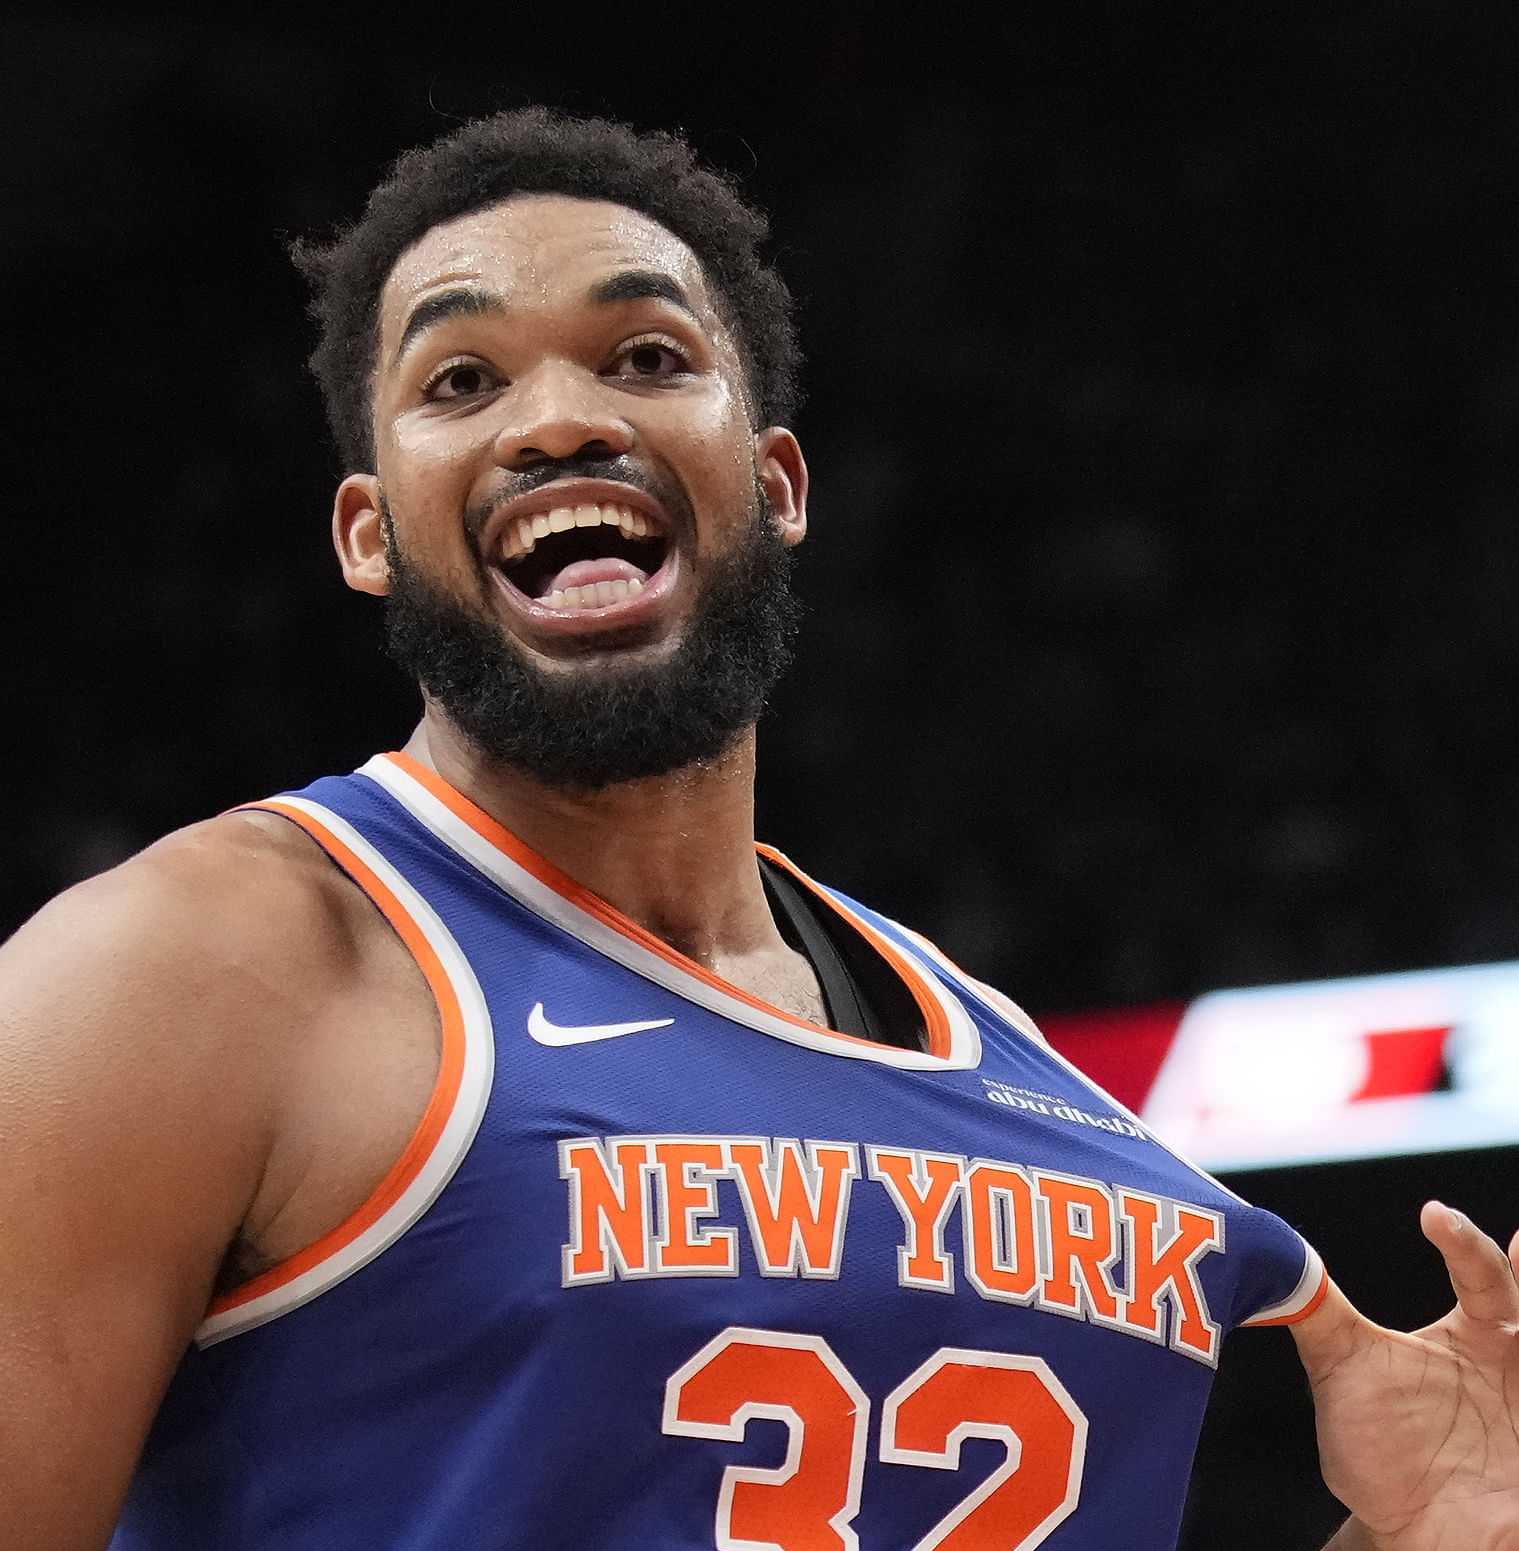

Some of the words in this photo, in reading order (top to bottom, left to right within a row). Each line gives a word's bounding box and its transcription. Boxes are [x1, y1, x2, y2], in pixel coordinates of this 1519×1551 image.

[987, 1090, 1050, 1116] abu
[1054, 1105, 1150, 1142] dhabi
[557, 1135, 861, 1289] NEW
[864, 1144, 1226, 1369] YORK
